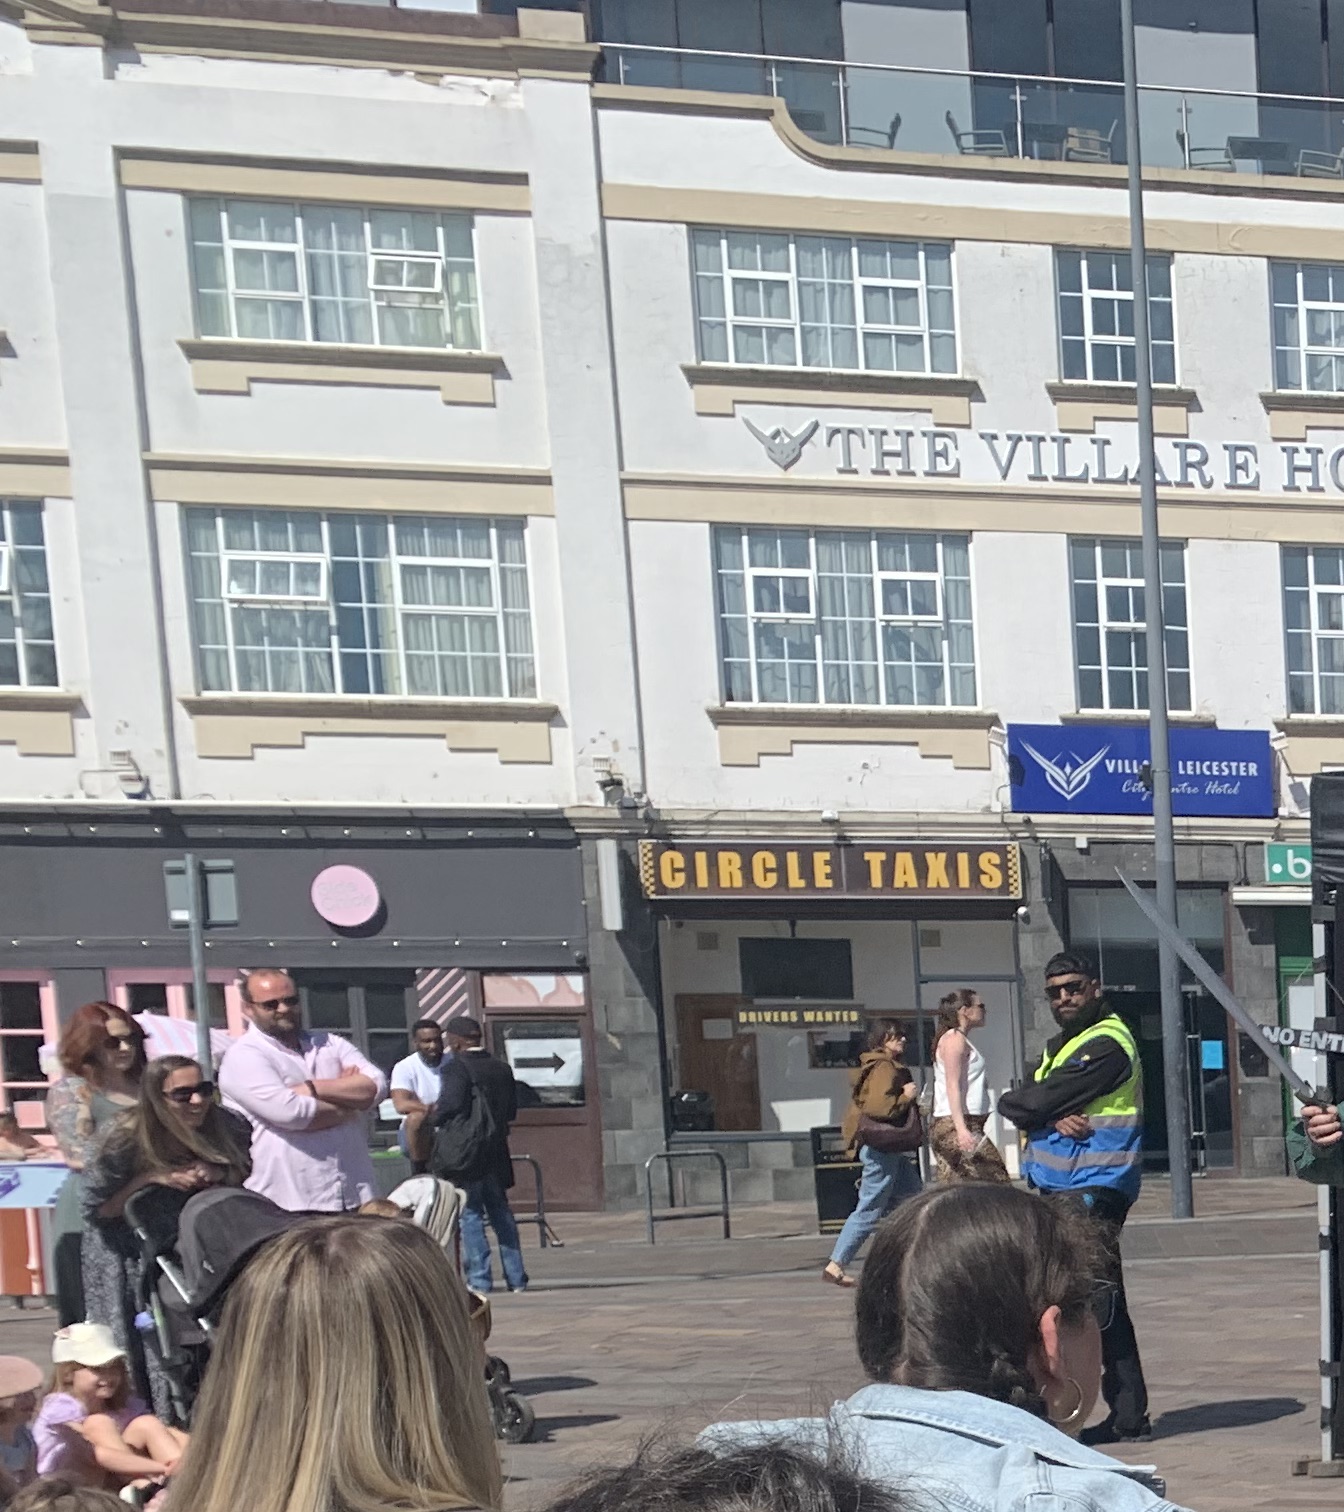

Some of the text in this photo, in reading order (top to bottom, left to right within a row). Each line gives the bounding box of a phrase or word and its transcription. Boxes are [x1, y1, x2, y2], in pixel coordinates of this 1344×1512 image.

[825, 424, 961, 478] THE
[978, 430, 1261, 492] VILLARE
[1178, 760, 1259, 777] LEICESTER
[1204, 780, 1241, 796] Hotel
[660, 850, 1003, 889] CIRCLE TAXIS
[739, 1010, 859, 1023] DRIVERS WANTED
[1261, 1025, 1295, 1046] NO
